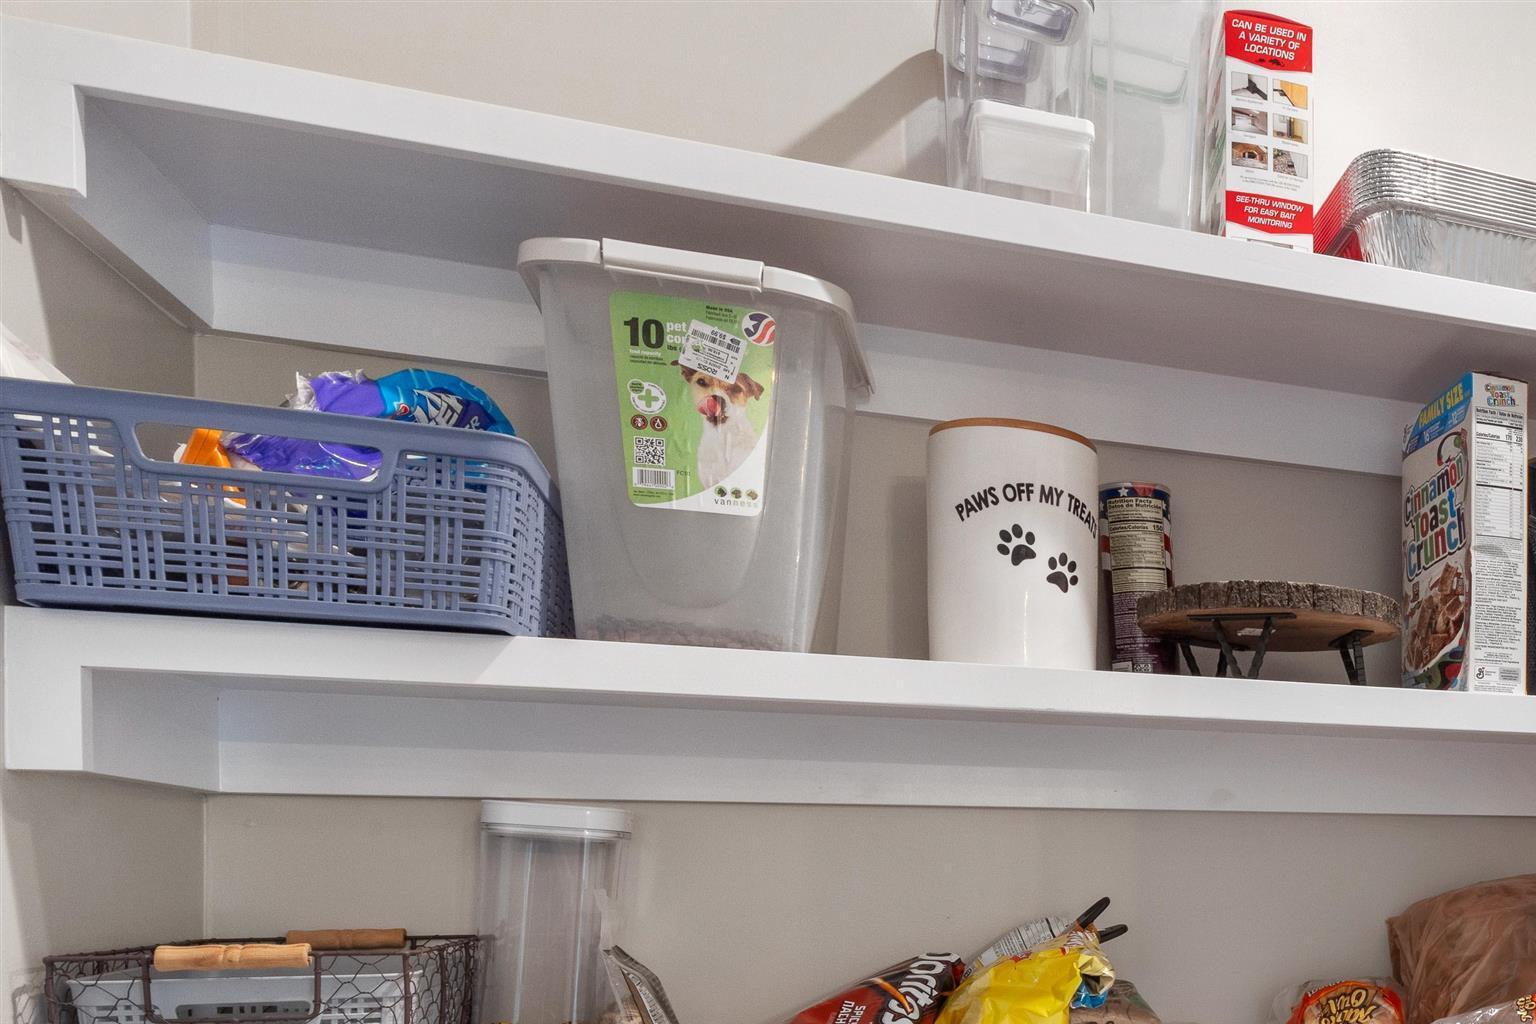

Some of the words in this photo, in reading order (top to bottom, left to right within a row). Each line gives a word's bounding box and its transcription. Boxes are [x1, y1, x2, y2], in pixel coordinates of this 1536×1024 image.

[1231, 18, 1252, 30] CAN
[1255, 23, 1267, 33] BE
[1269, 26, 1294, 38] USED
[1296, 32, 1307, 42] IN
[1239, 31, 1246, 40] A
[1248, 32, 1287, 47] VARIETY
[1288, 41, 1300, 51] OF
[1244, 43, 1295, 60] LOCATIONS
[1236, 195, 1270, 206] SEE-THRU
[1272, 200, 1304, 212] WINDOW
[1244, 206, 1258, 214] FOR
[1260, 207, 1278, 217] EASY
[1280, 211, 1296, 220] BAIT
[1247, 215, 1293, 229] MONITORING
[623, 316, 665, 349] 10
[666, 321, 687, 333] pet
[697, 362, 718, 376] ROSS
[1419, 398, 1445, 429] FAMILY
[1446, 383, 1464, 408] SIZE
[1405, 453, 1464, 522] Cinnamon
[955, 486, 999, 522] PAWS
[1002, 482, 1034, 502] OFF
[1039, 484, 1064, 507] MY
[1067, 493, 1099, 539] TREATS
[1414, 488, 1456, 542] Toast
[1407, 506, 1466, 572] Crunch
